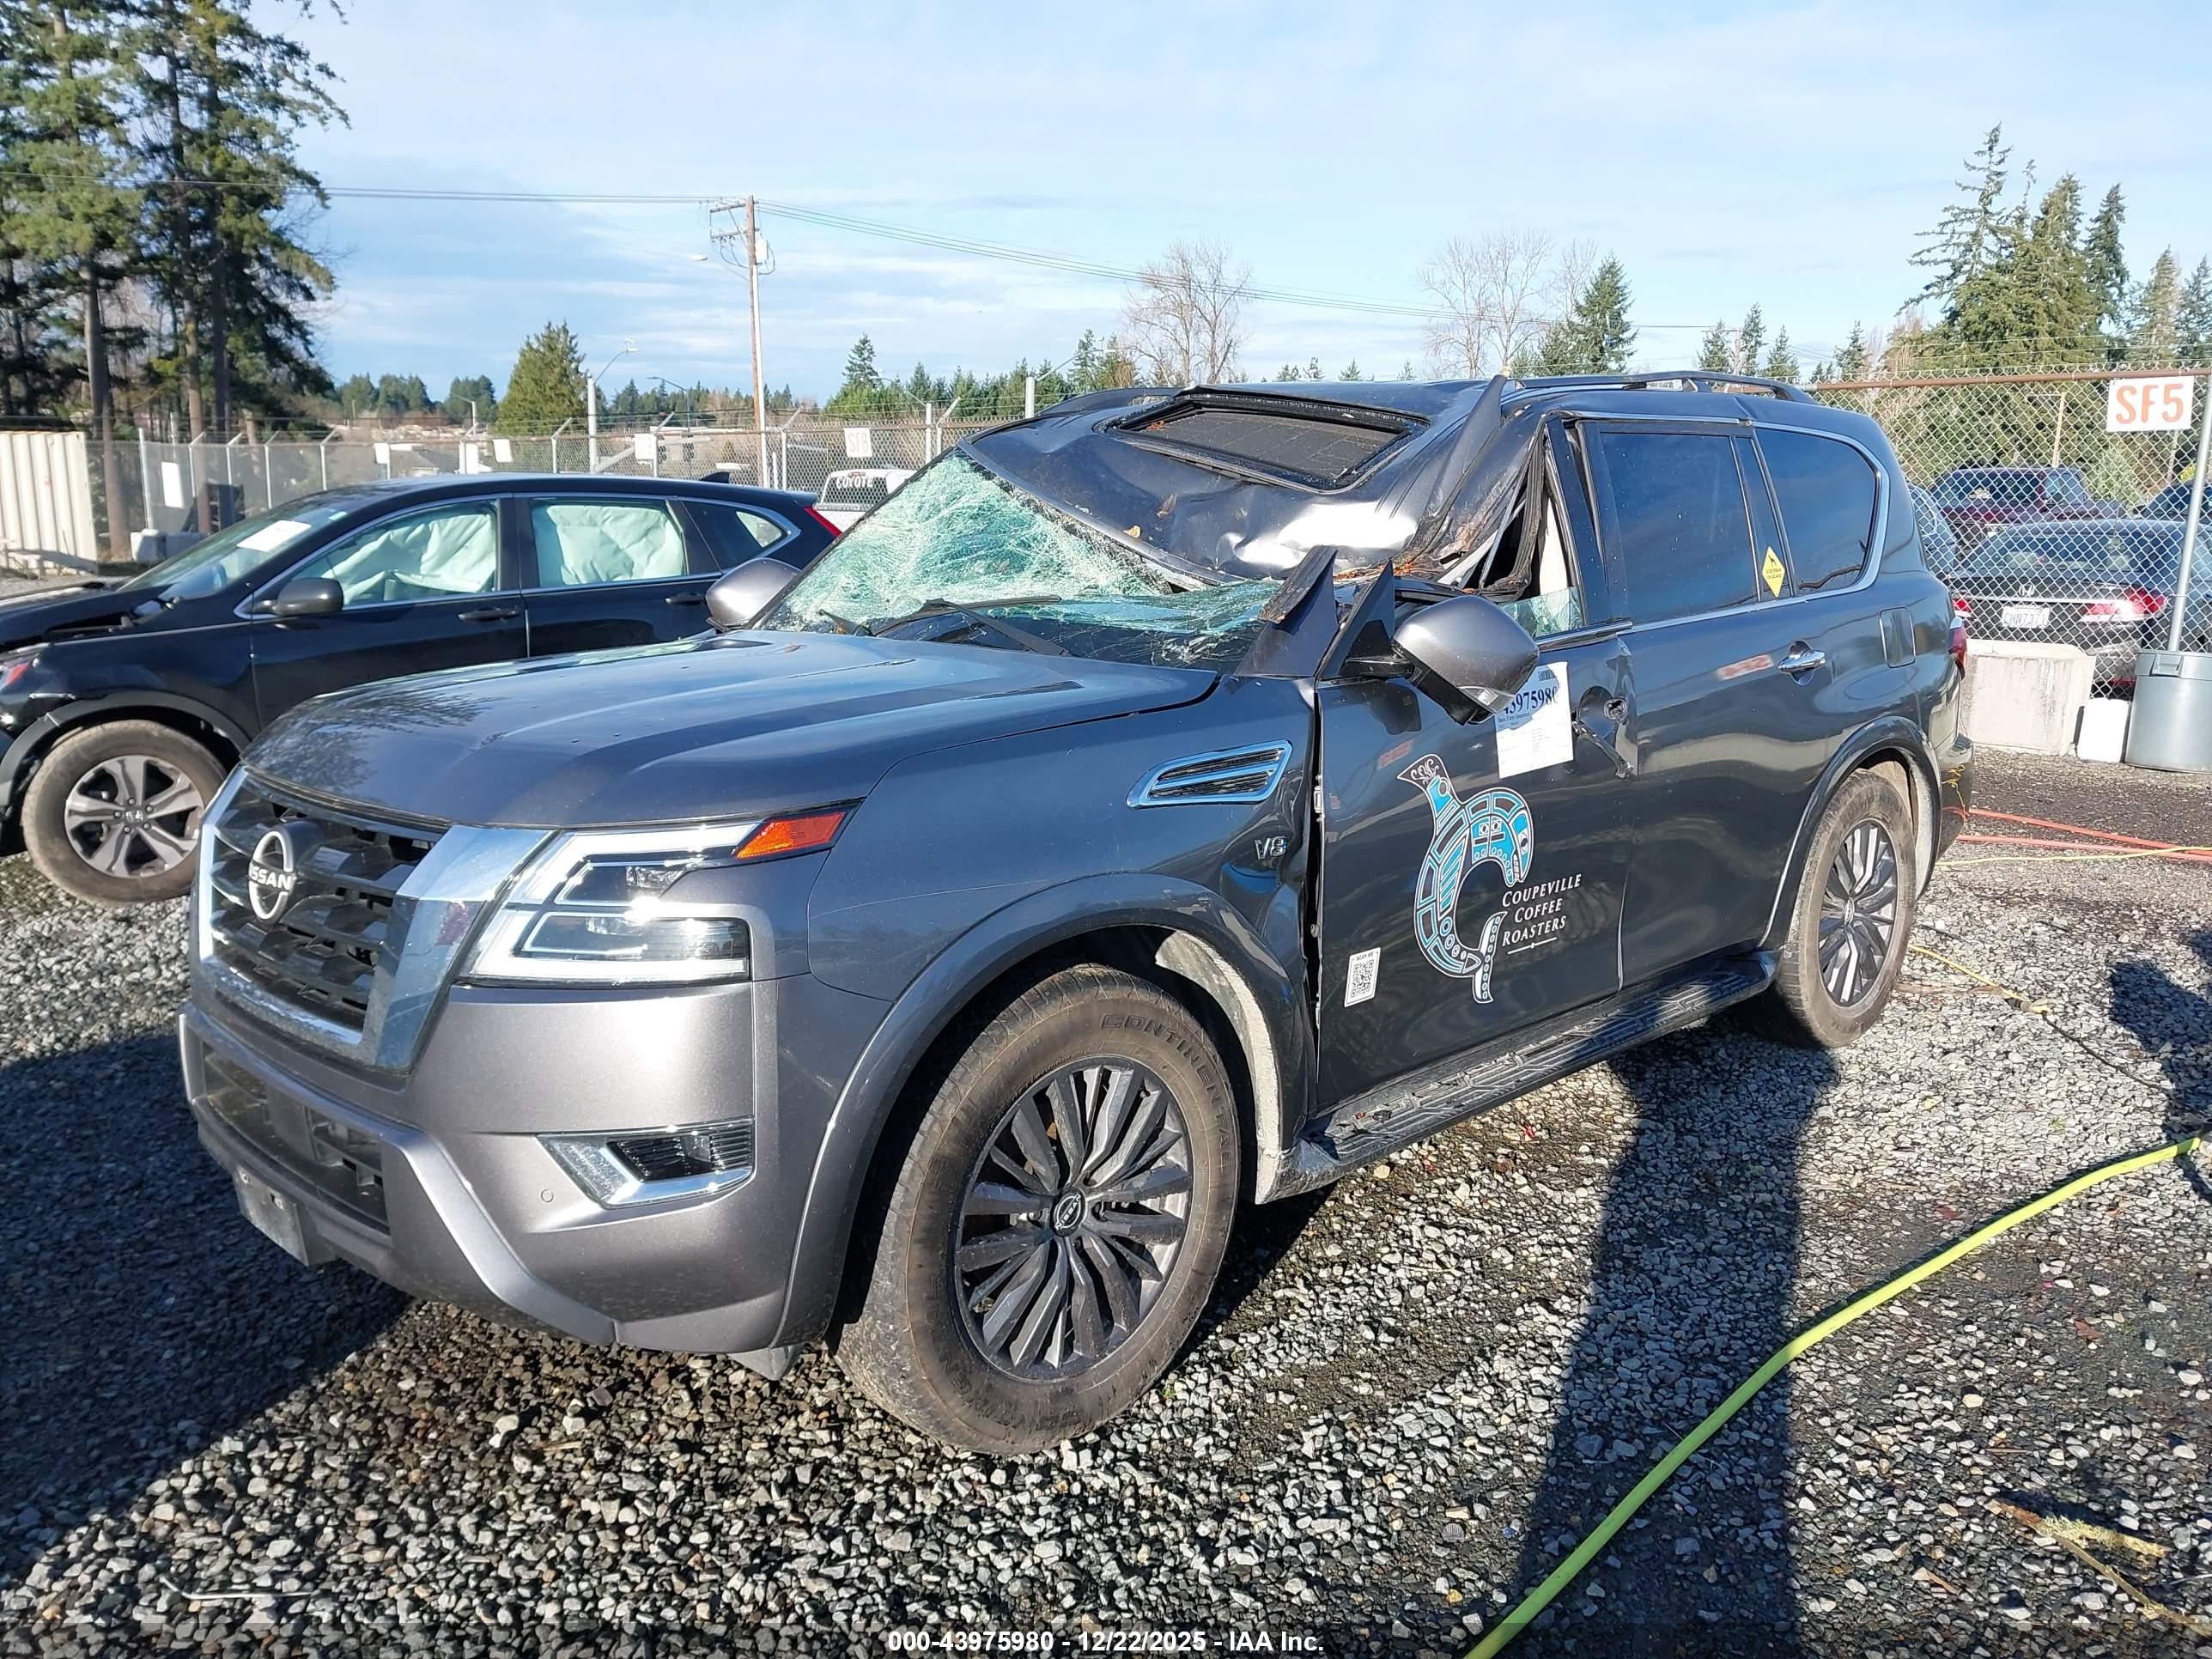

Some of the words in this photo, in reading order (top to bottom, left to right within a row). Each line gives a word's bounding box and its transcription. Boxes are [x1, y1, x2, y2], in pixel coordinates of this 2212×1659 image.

[2115, 383, 2185, 424] SF5
[836, 476, 873, 488] COYOTE
[1255, 836, 1286, 860] V8
[1502, 873, 1582, 907] COUPEVILLE
[1514, 898, 1563, 923] COFFEE
[1502, 915, 1566, 946] ROASTERS
[1054, 1191, 1081, 1231] NISSAN
